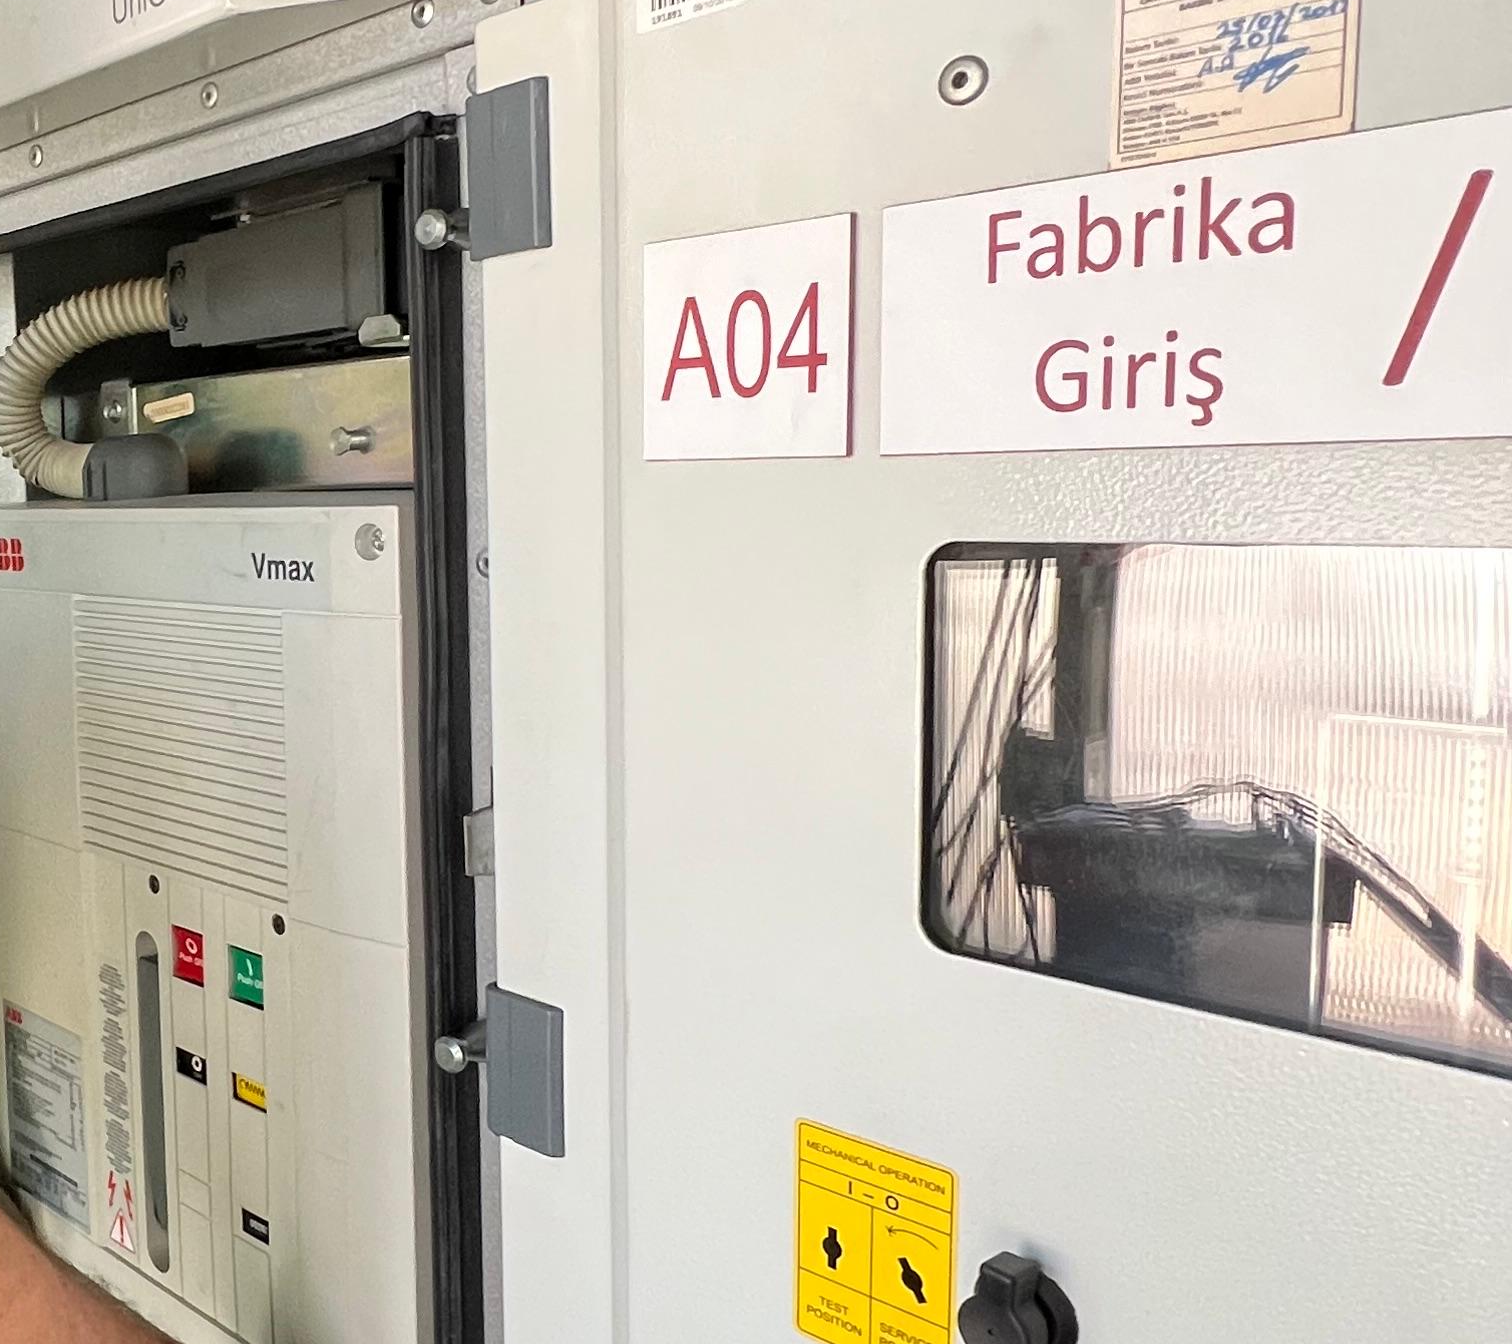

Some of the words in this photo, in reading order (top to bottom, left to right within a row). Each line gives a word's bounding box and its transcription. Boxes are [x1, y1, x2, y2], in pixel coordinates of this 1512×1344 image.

[986, 177, 1296, 284] Fabrika
[660, 282, 828, 402] A04
[1034, 330, 1225, 427] Giriş
[251, 552, 316, 583] Vmax
[806, 1139, 877, 1172] MECHANICAL
[878, 1164, 946, 1196] OPERATION
[806, 1306, 863, 1337] POSITION
[819, 1296, 849, 1316] TEST
